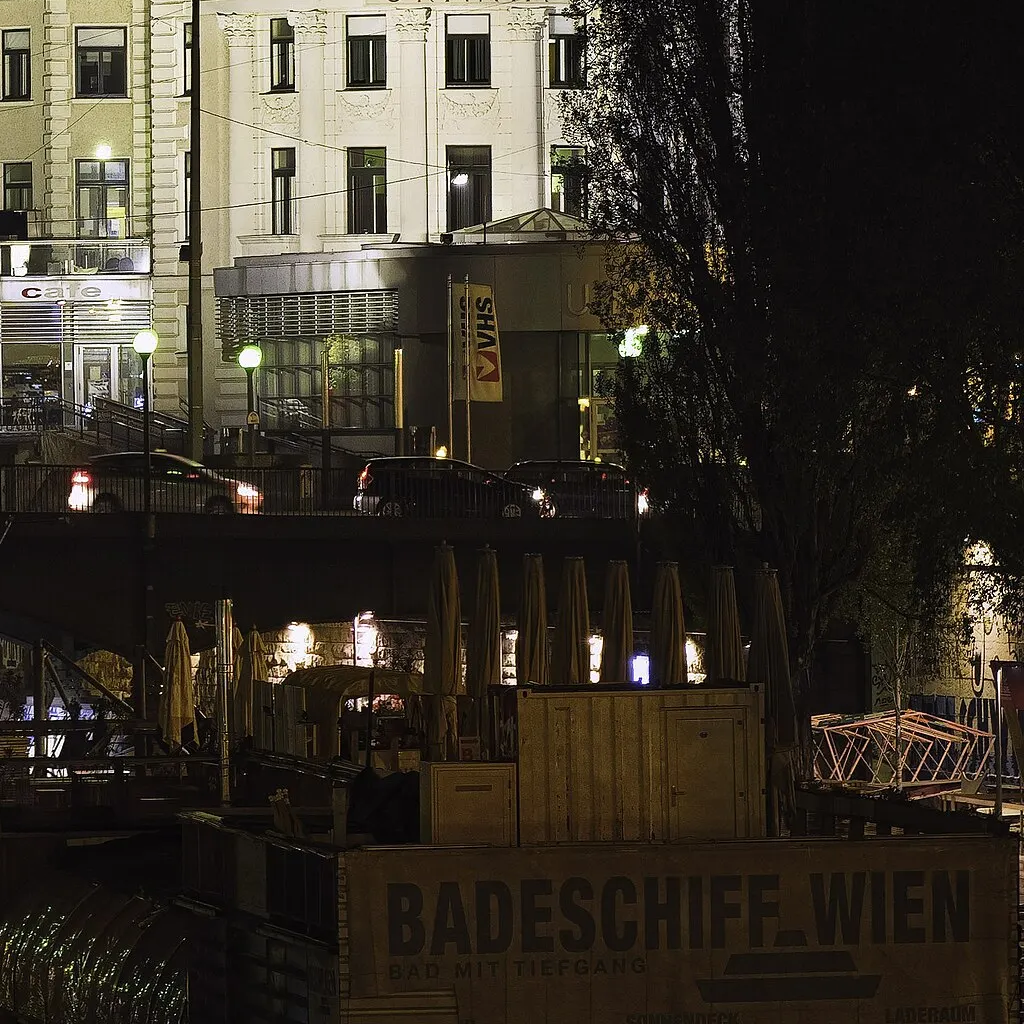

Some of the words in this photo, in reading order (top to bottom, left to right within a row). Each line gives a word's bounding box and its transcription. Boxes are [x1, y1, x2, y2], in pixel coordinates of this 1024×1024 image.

[476, 296, 497, 350] VHS
[386, 874, 780, 957] BADESCHIFF
[808, 870, 971, 948] WIEN
[389, 962, 440, 981] BAD
[454, 961, 501, 979] MIT
[513, 957, 648, 977] TIEFGANG
[884, 1005, 976, 1024] LADERAUM
